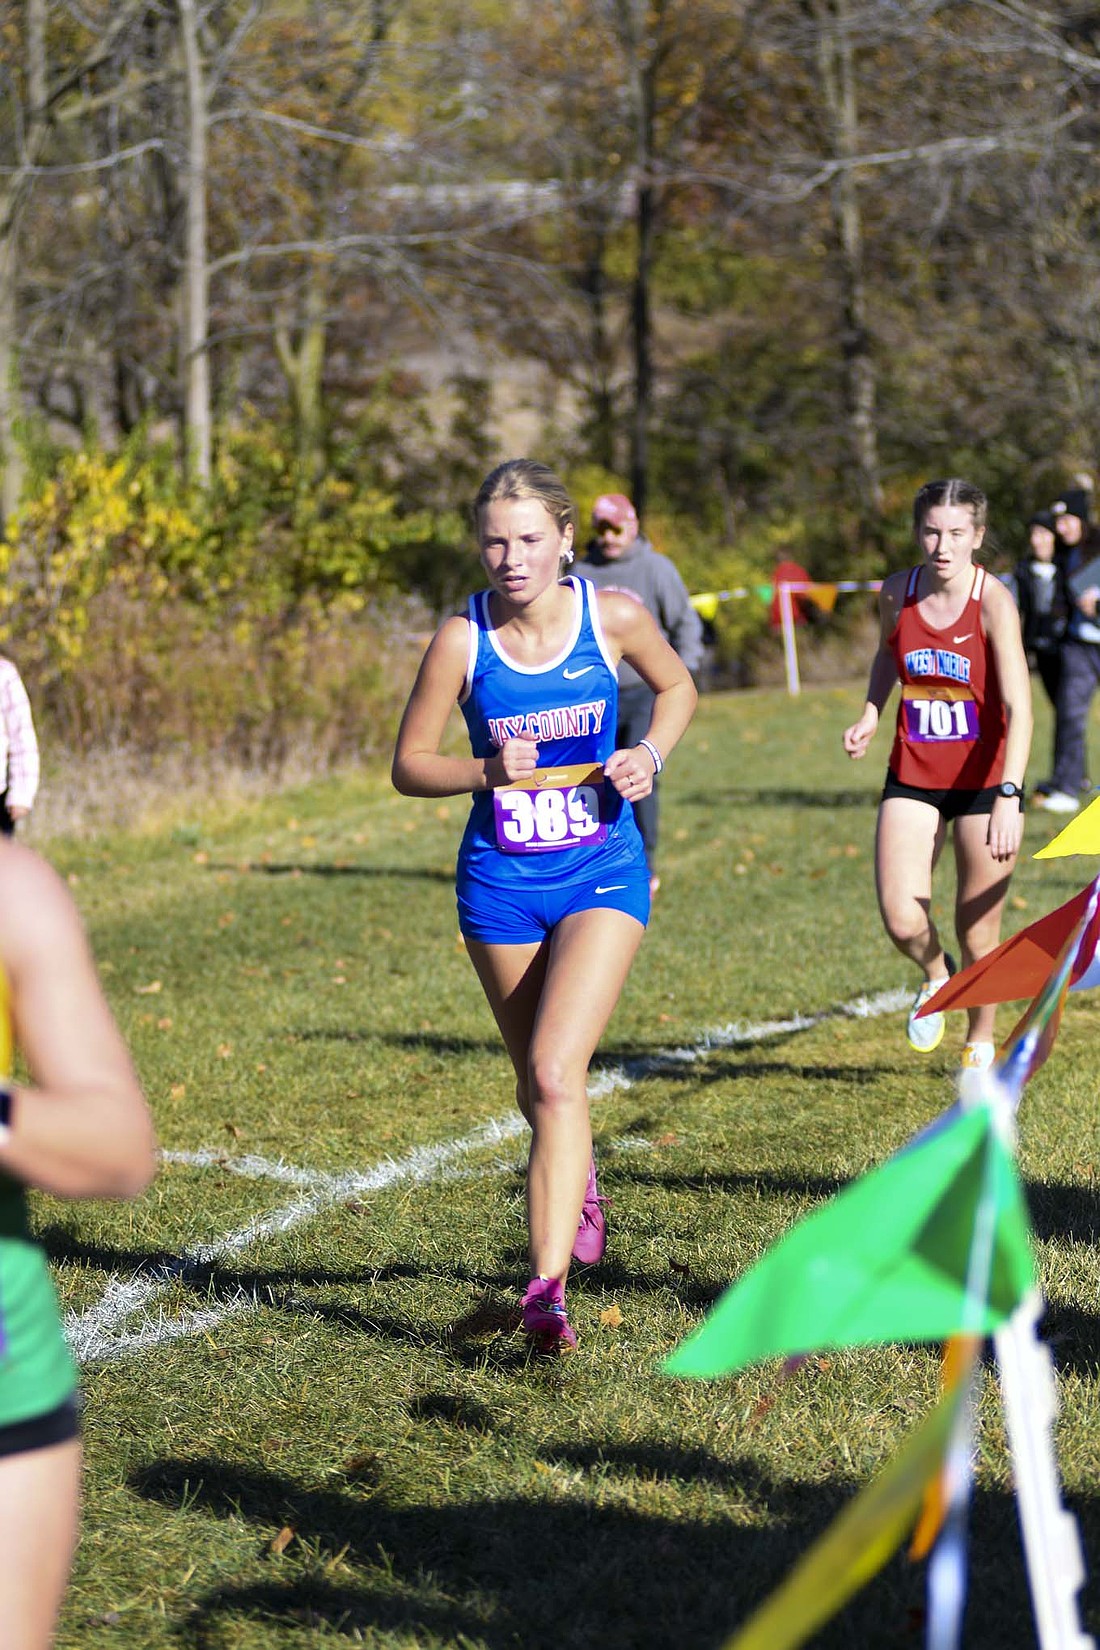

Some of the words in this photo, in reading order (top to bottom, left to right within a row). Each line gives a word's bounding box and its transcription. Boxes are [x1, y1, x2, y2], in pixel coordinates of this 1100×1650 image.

[905, 648, 936, 676] WEST
[937, 649, 971, 683] NOBLE
[525, 699, 606, 743] COUNTY
[912, 700, 970, 735] 701
[501, 785, 600, 842] 389
